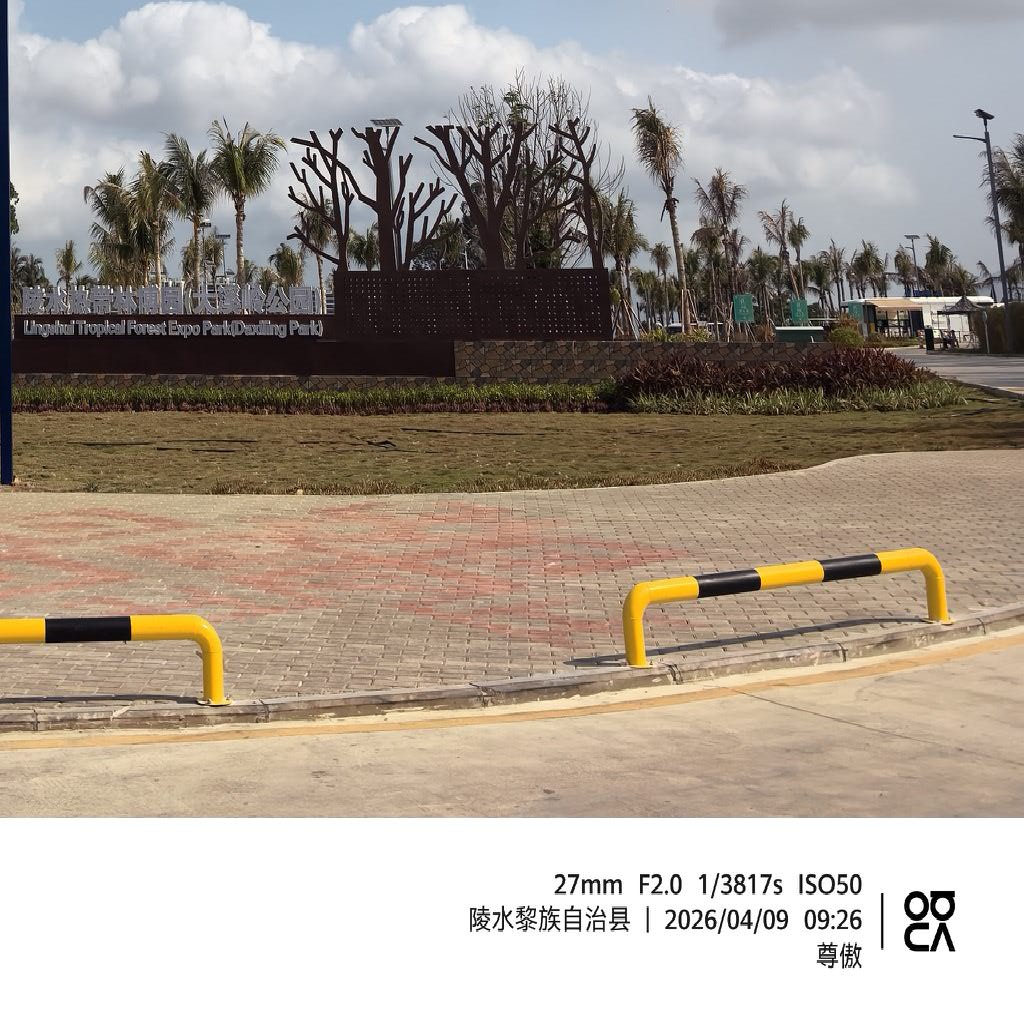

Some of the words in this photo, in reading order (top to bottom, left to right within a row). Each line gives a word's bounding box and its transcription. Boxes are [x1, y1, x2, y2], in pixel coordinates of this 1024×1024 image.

[23, 319, 75, 338] Lingshui
[75, 319, 126, 338] Tropical
[127, 319, 167, 336] Forest
[168, 319, 201, 338] Expo
[289, 319, 324, 337] Park)
